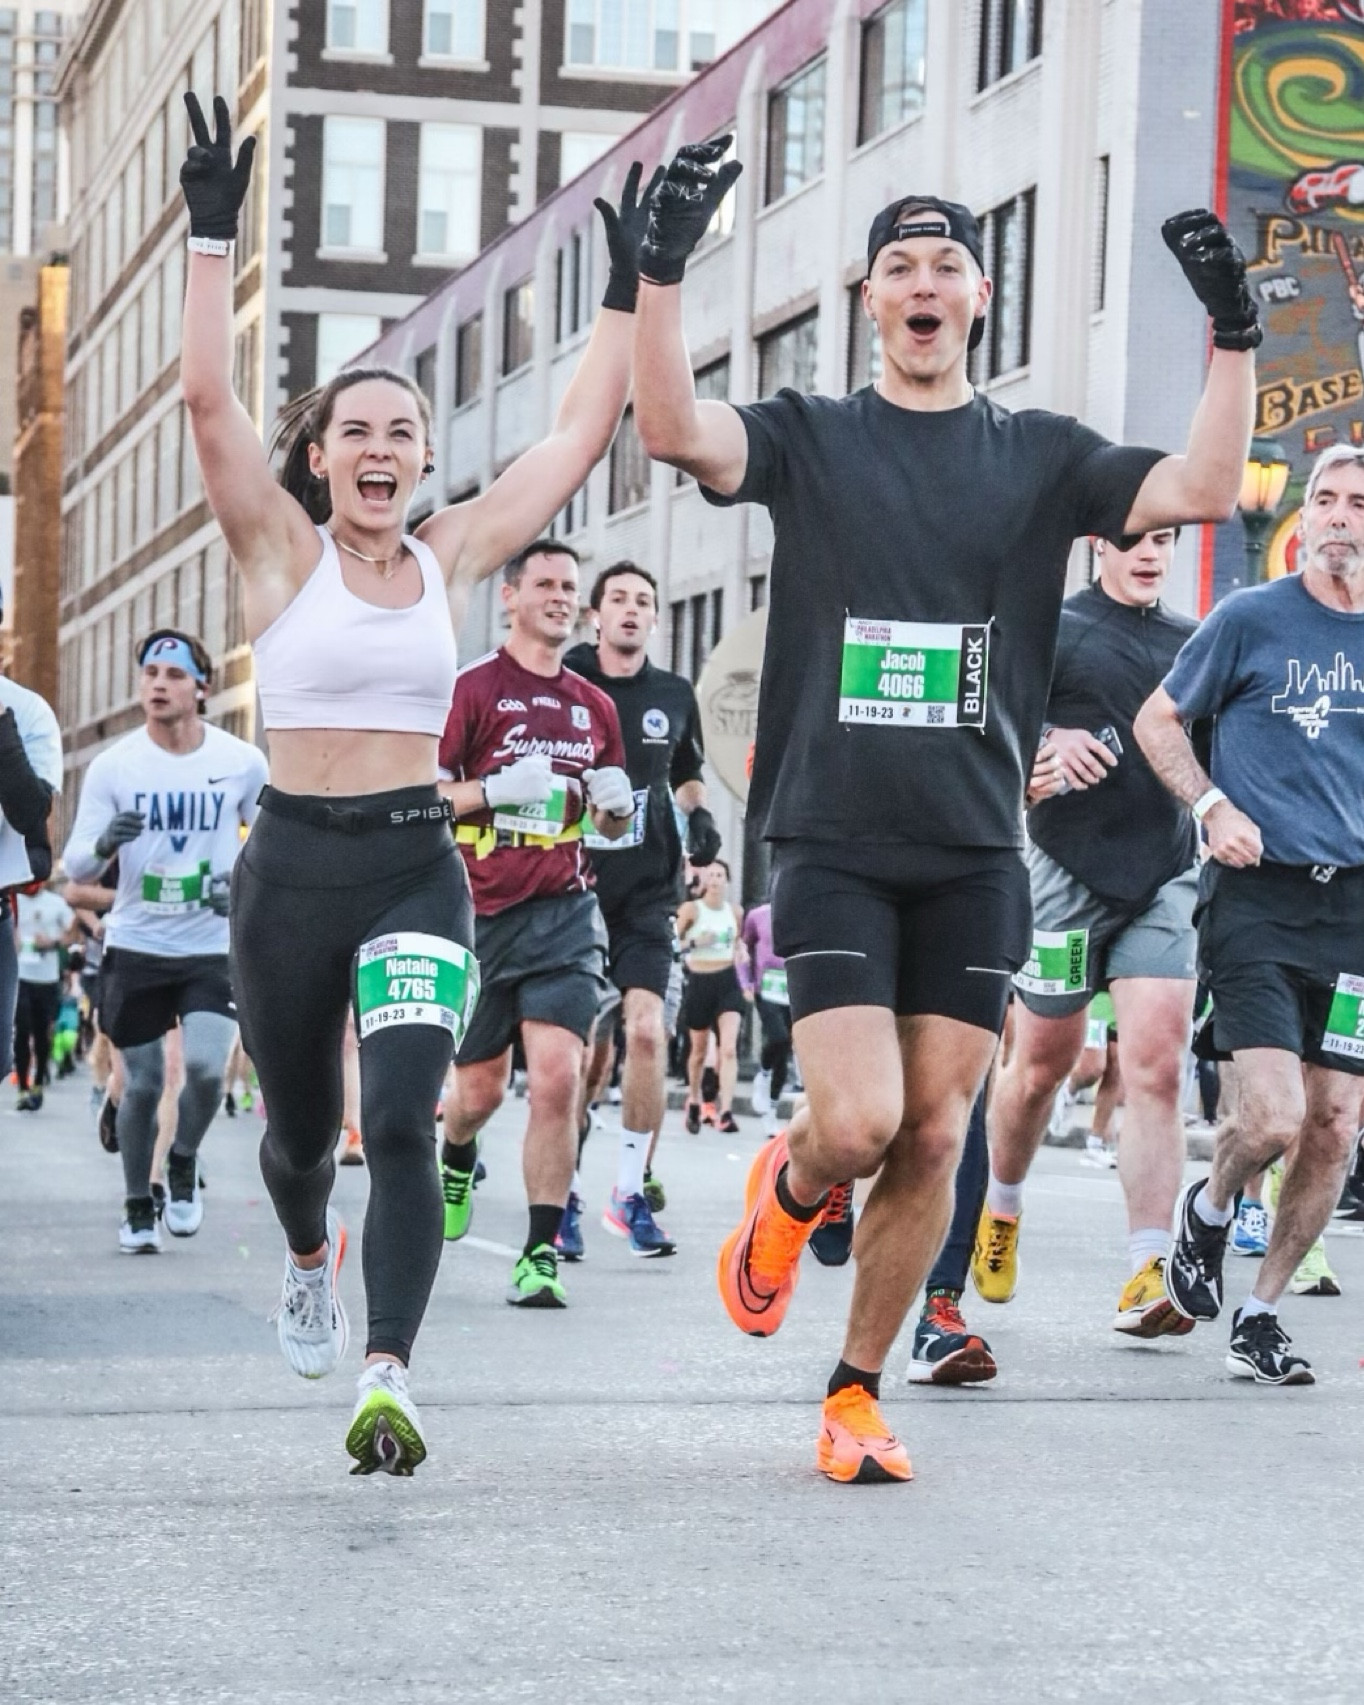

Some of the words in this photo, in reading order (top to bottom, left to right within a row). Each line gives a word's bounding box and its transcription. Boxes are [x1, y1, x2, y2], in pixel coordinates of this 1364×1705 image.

[1260, 277, 1300, 302] PBC
[881, 650, 926, 672] Jacob
[878, 672, 924, 699] 4066
[964, 637, 984, 714] BLACK
[849, 704, 894, 719] 11-19-23
[386, 957, 438, 978] Natalie
[1070, 937, 1083, 985] GREEN
[387, 977, 436, 1001] 4765
[366, 1008, 405, 1029] 11-19-23
